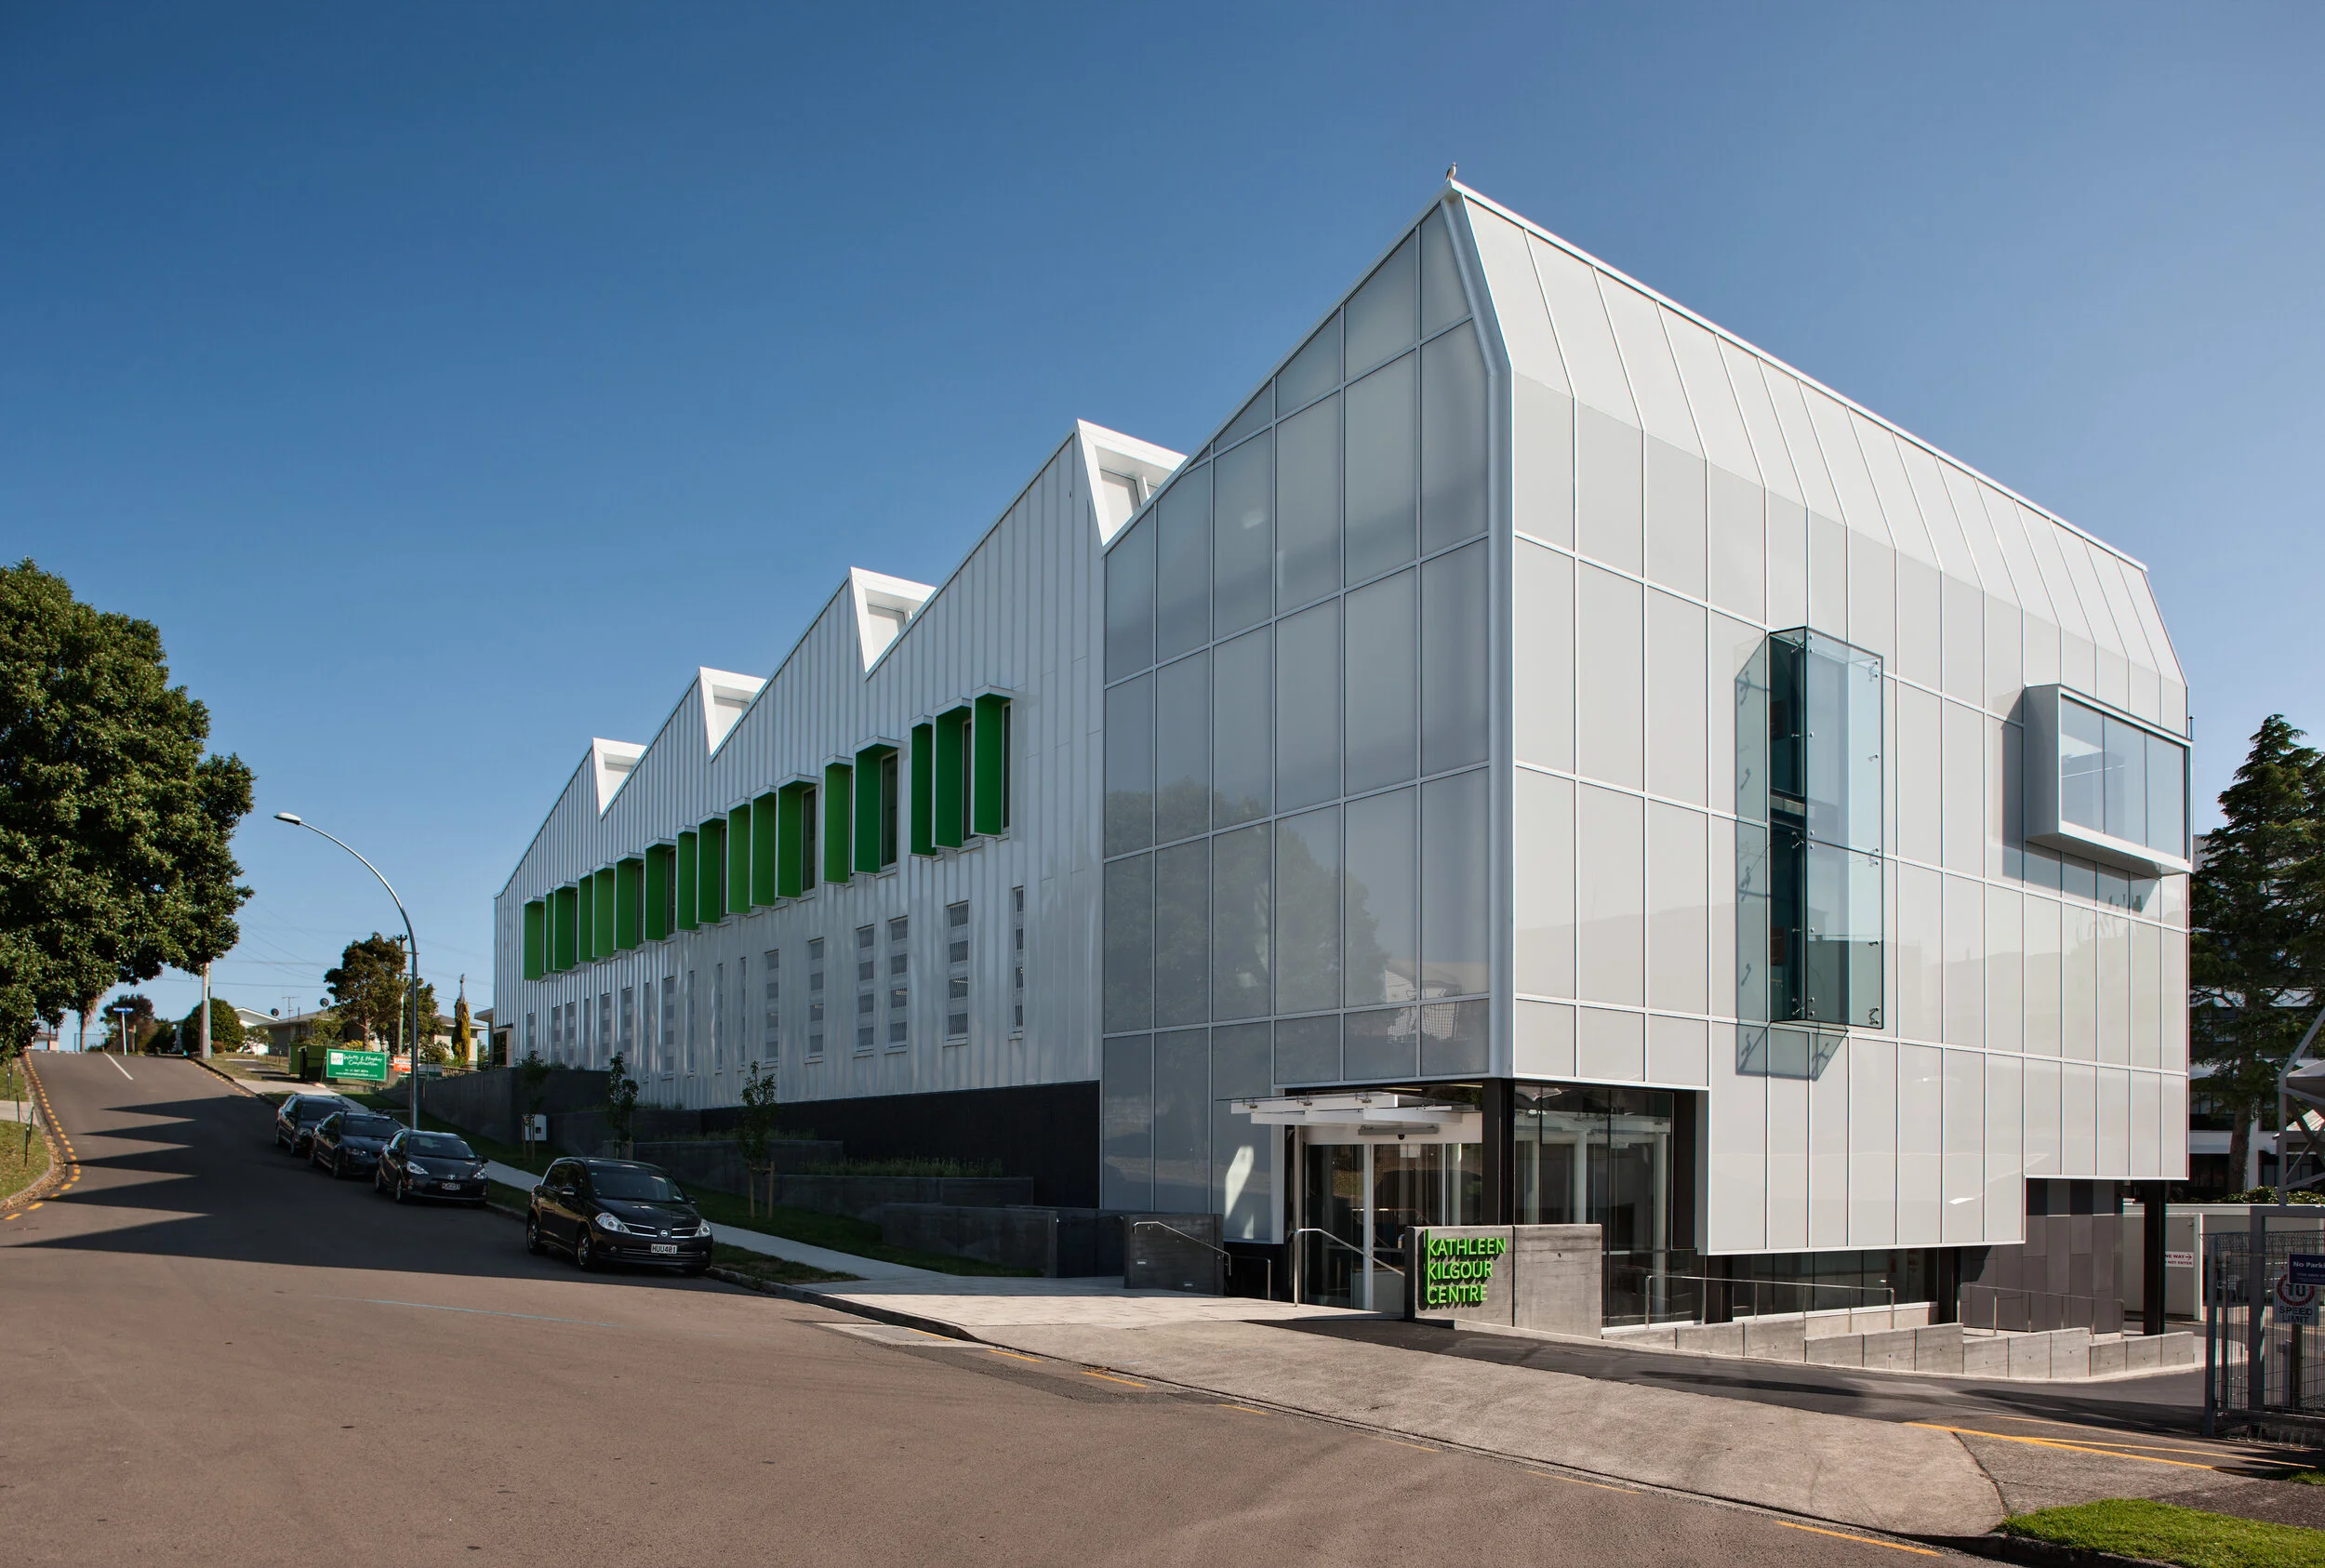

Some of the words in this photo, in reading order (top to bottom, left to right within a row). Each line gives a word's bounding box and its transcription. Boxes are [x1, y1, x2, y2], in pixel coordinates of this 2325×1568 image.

[1425, 1237, 1507, 1256] KATHLEEN
[1425, 1261, 1494, 1281] KILGOUR
[1426, 1284, 1489, 1305] CENTRE
[2278, 1307, 2313, 1316] SPEED
[2282, 1314, 2309, 1323] LIMIT
